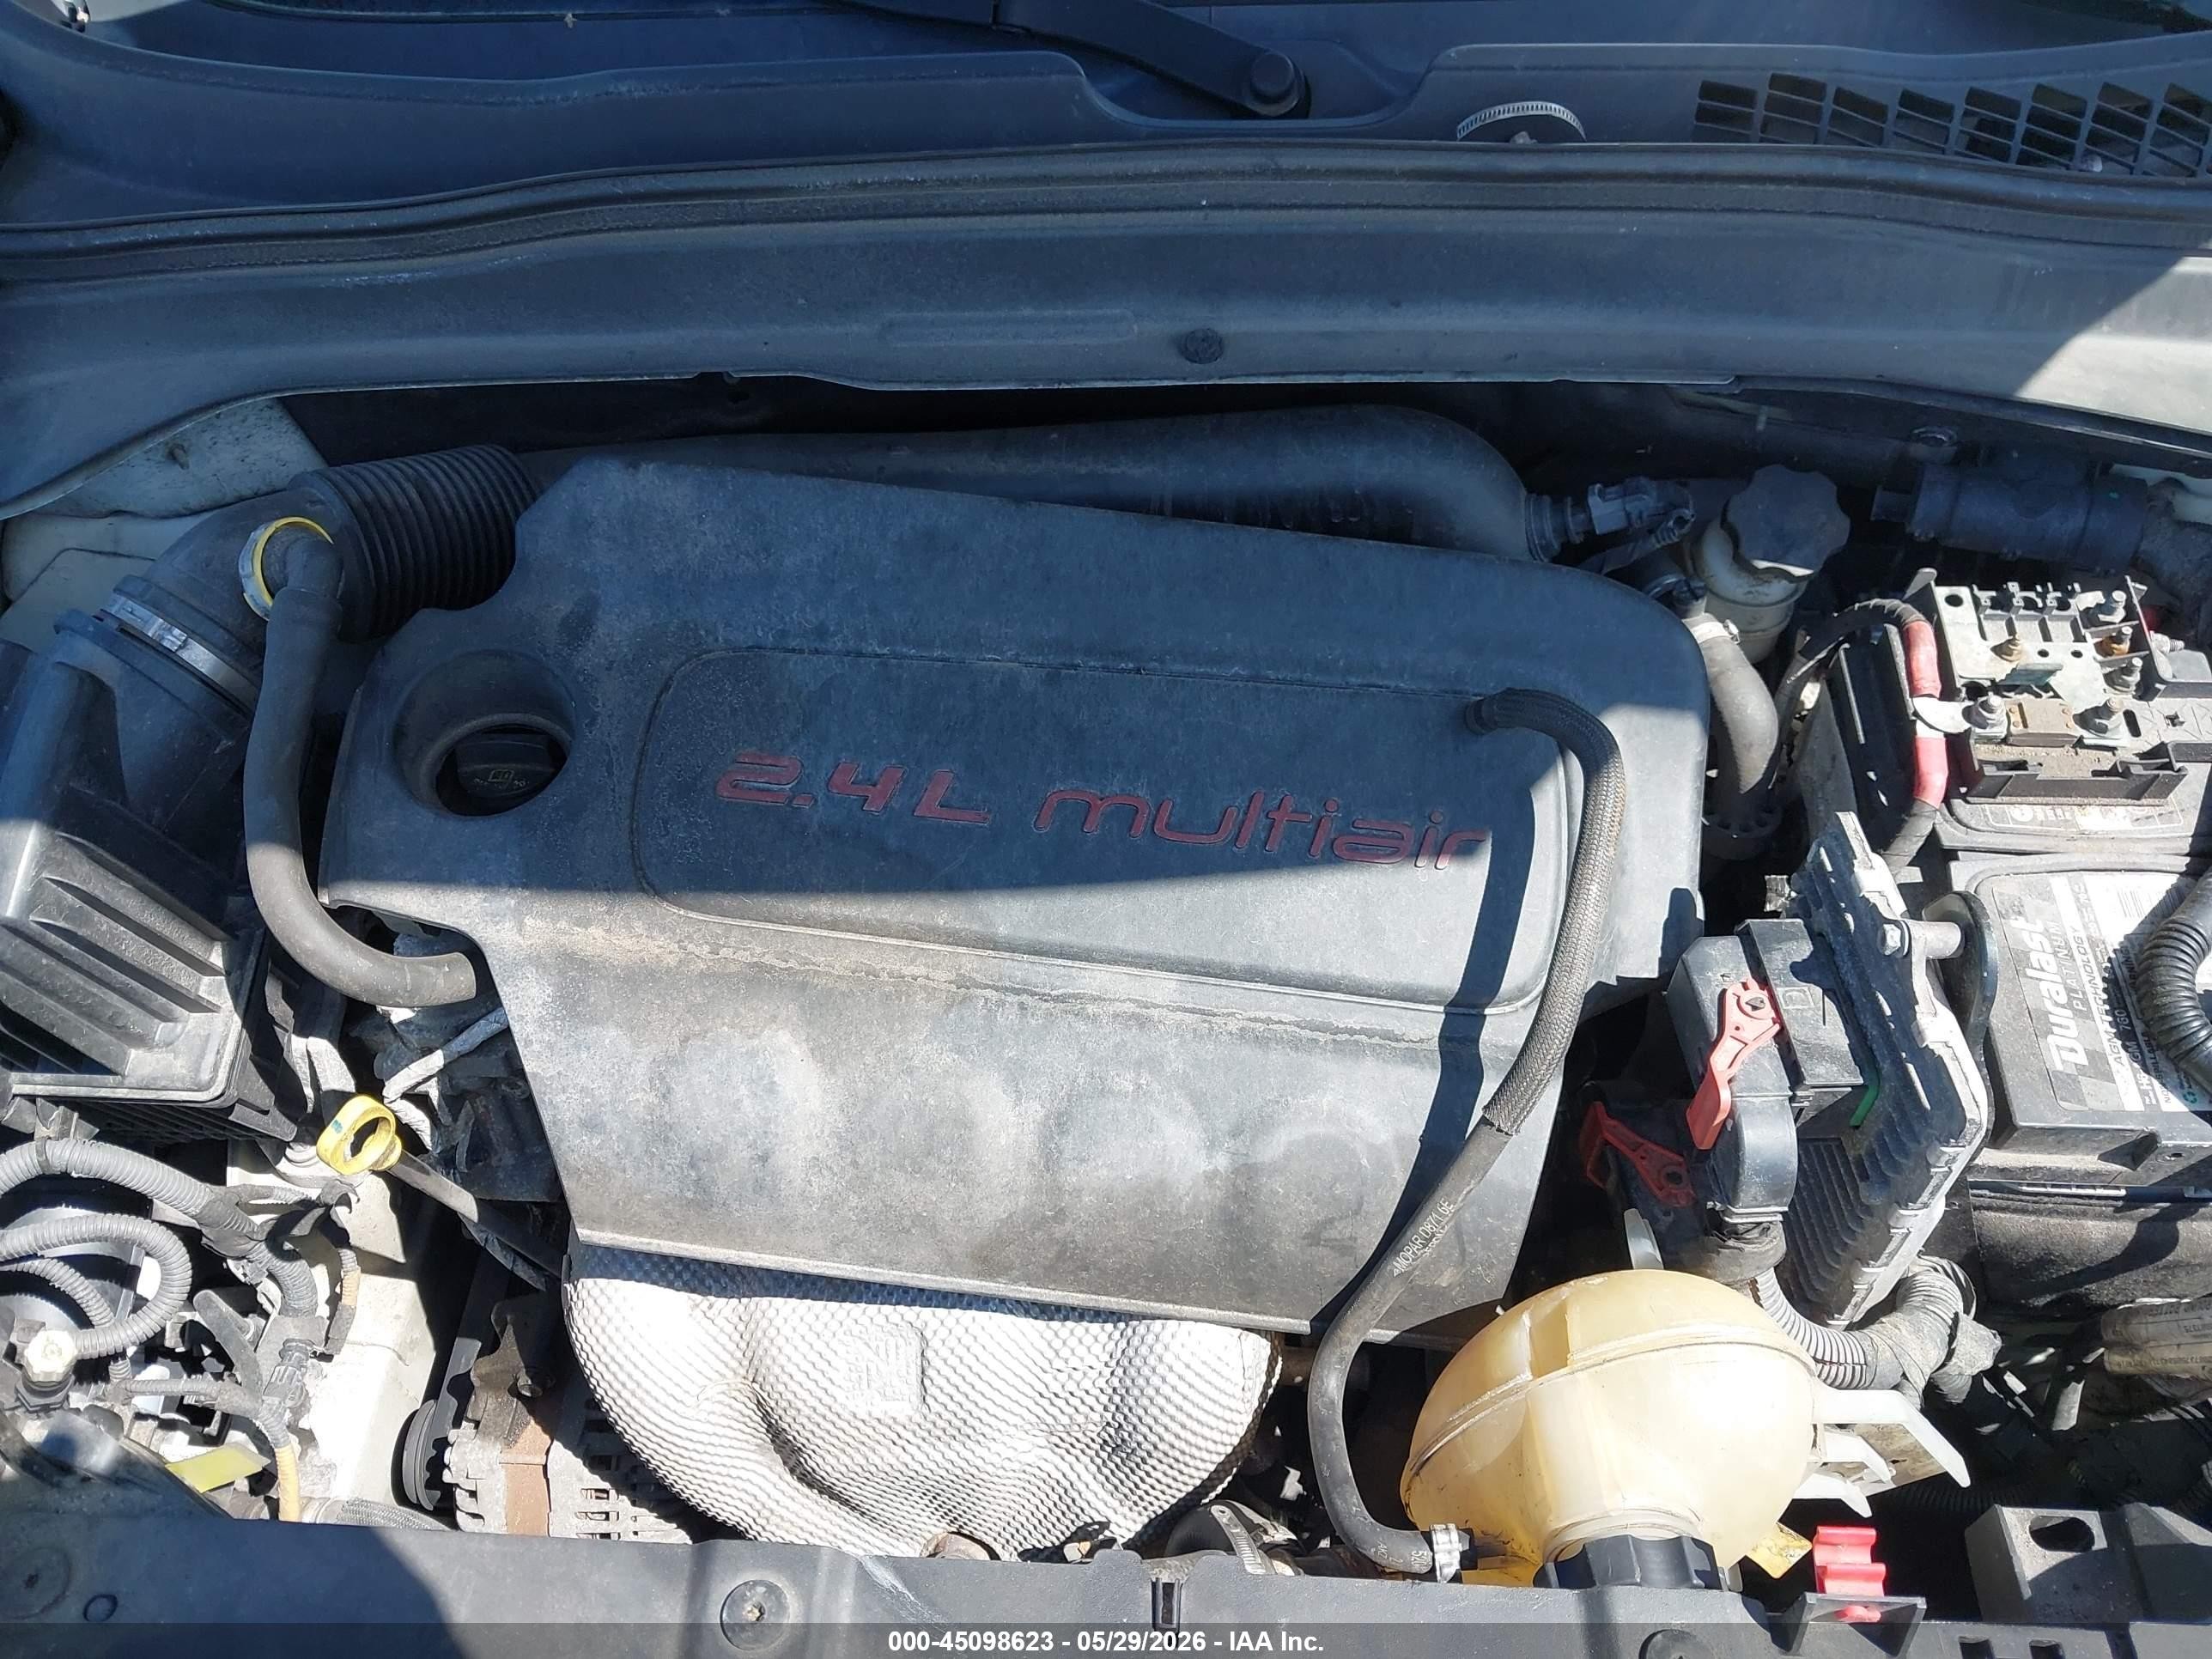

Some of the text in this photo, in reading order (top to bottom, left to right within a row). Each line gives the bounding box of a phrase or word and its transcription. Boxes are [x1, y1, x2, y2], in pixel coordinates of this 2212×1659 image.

[1034, 787, 1492, 870] multiair
[2010, 916, 2089, 1072] Duralast
[2053, 921, 2087, 1012] PLATINUM
[2070, 927, 2109, 1024] TECHNOLOGY
[2104, 1028, 2124, 1066] AGM
[1393, 1235, 1425, 1273] MOPAR
[1419, 1211, 1443, 1238] D871
